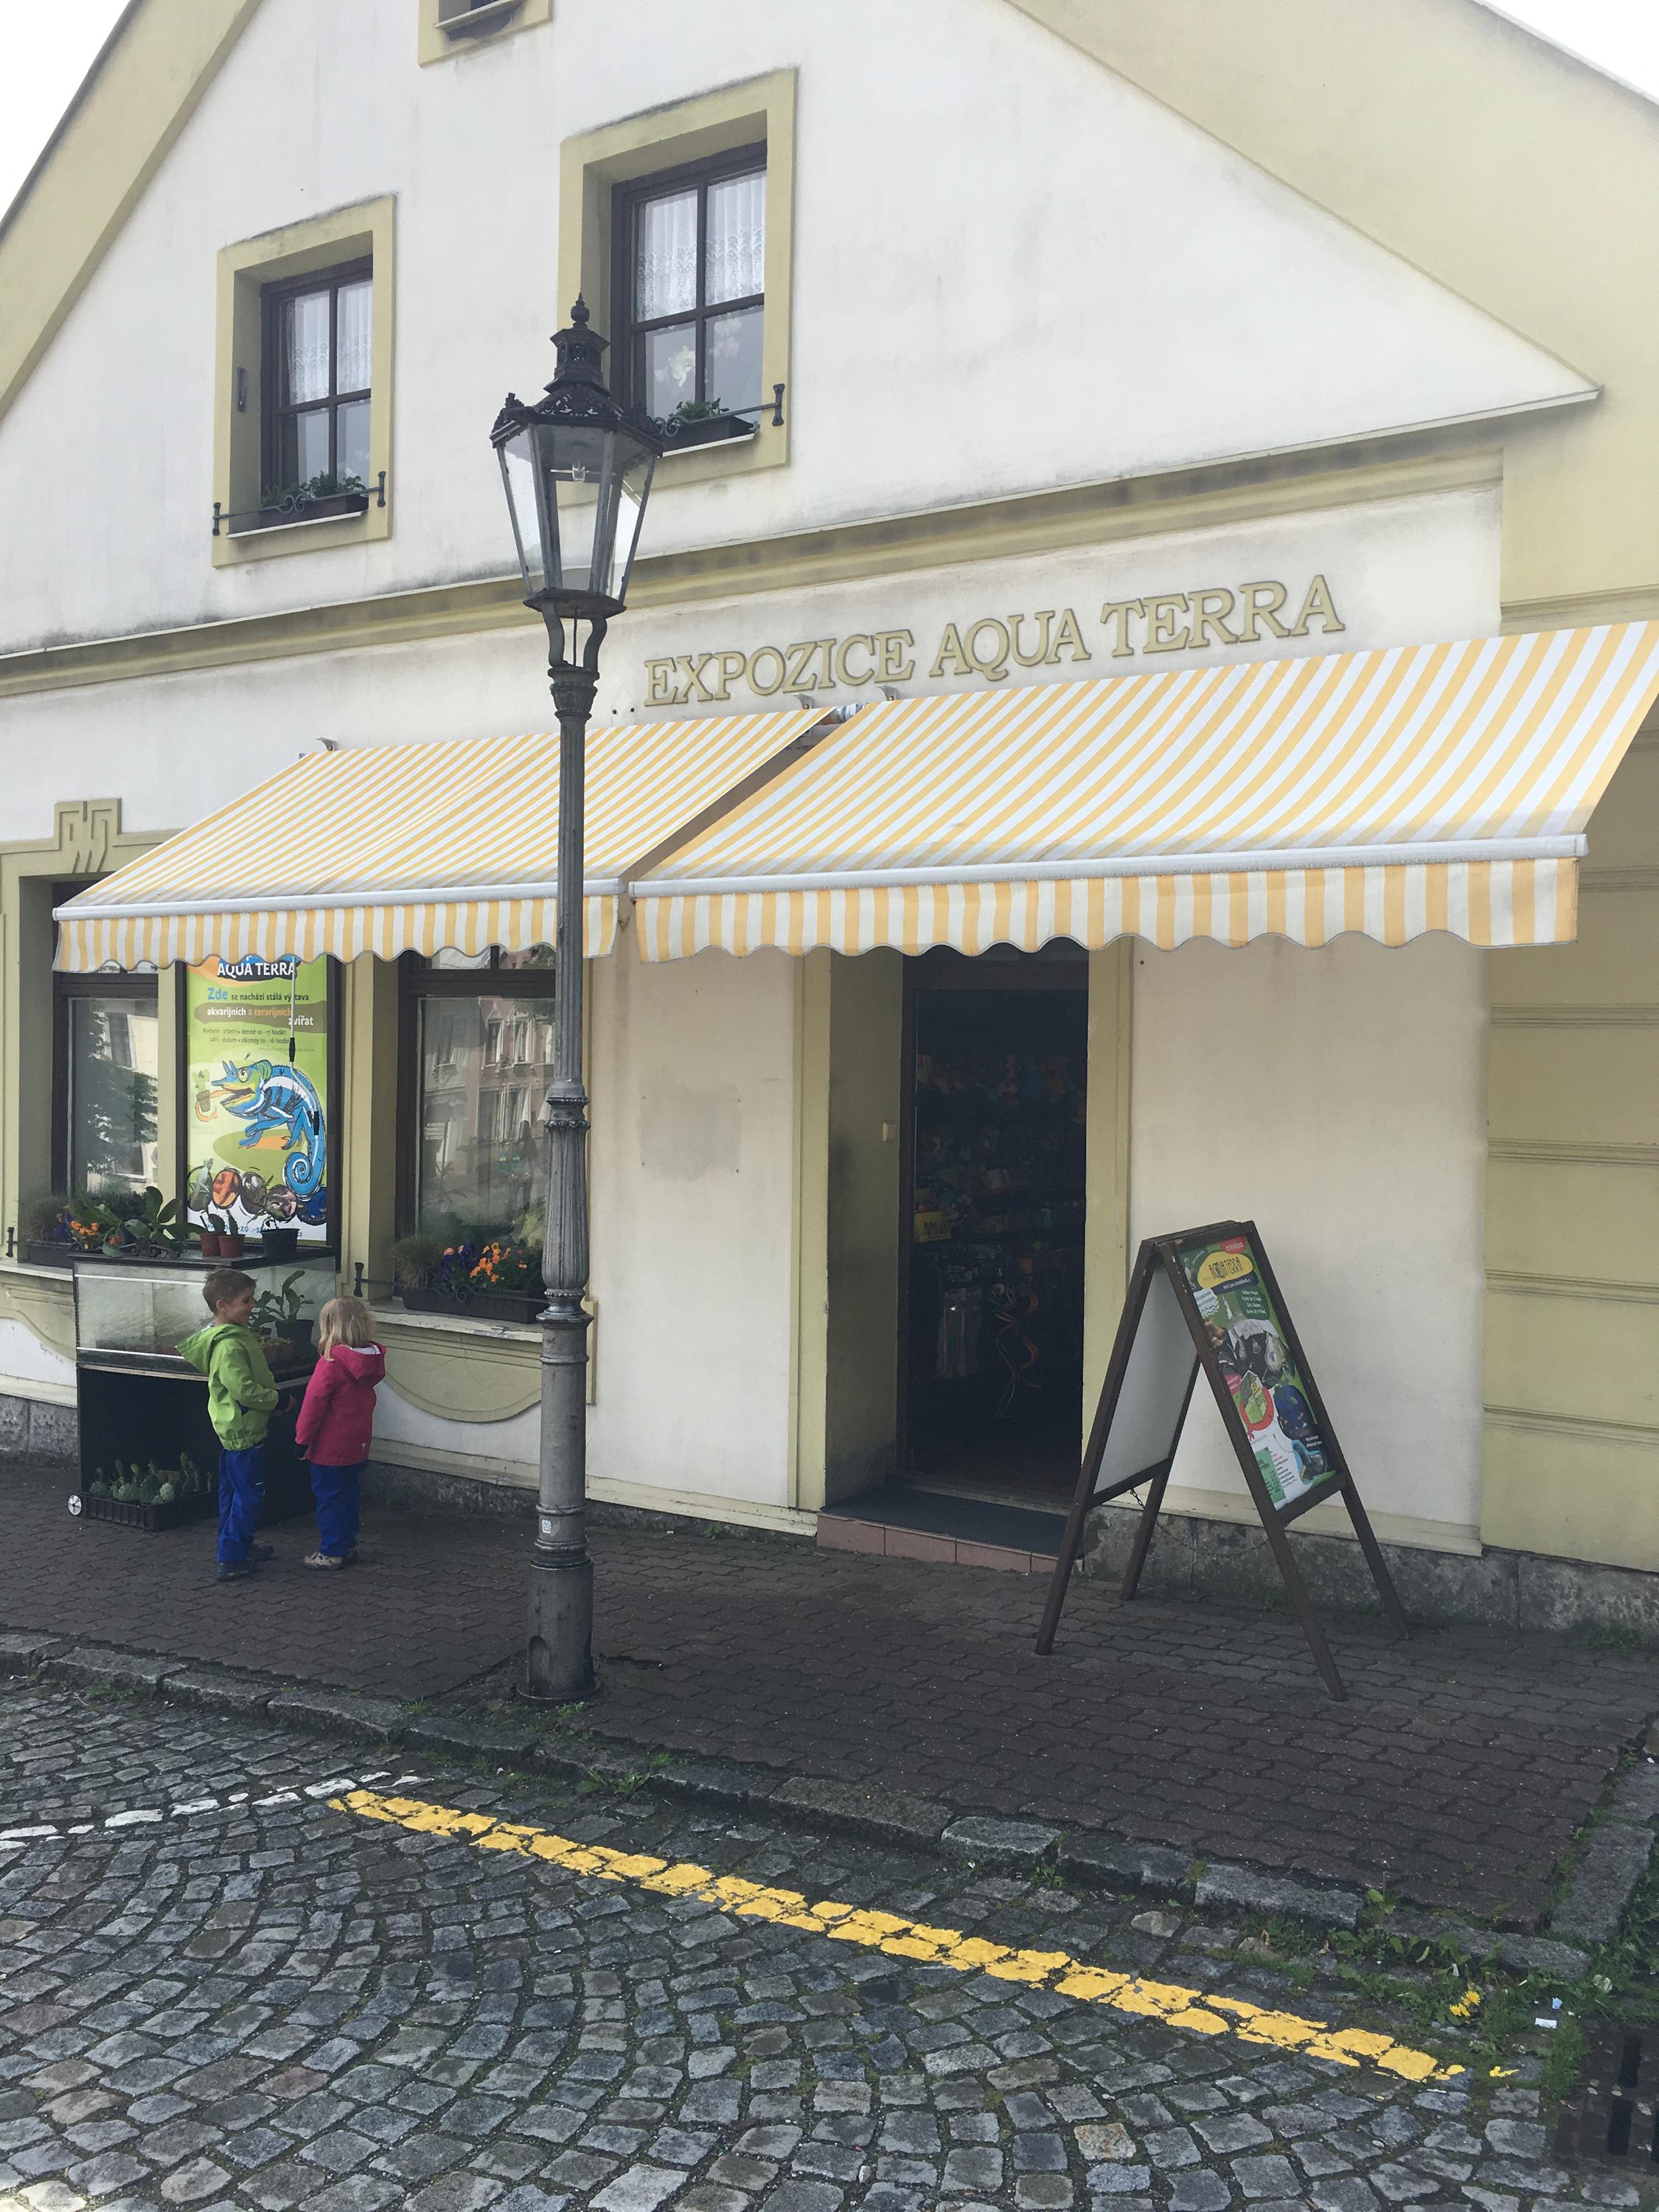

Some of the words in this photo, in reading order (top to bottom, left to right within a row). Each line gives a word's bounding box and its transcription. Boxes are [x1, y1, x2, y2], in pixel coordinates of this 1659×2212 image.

[643, 630, 915, 706] EXPOZICE
[929, 608, 1090, 681] AQUA
[1100, 574, 1345, 655] TERRA
[217, 962, 253, 978] AQUA
[255, 961, 295, 975] TERRA
[207, 987, 228, 1000] Zde
[284, 994, 309, 1002] výtava
[207, 1007, 246, 1018] akvarijních
